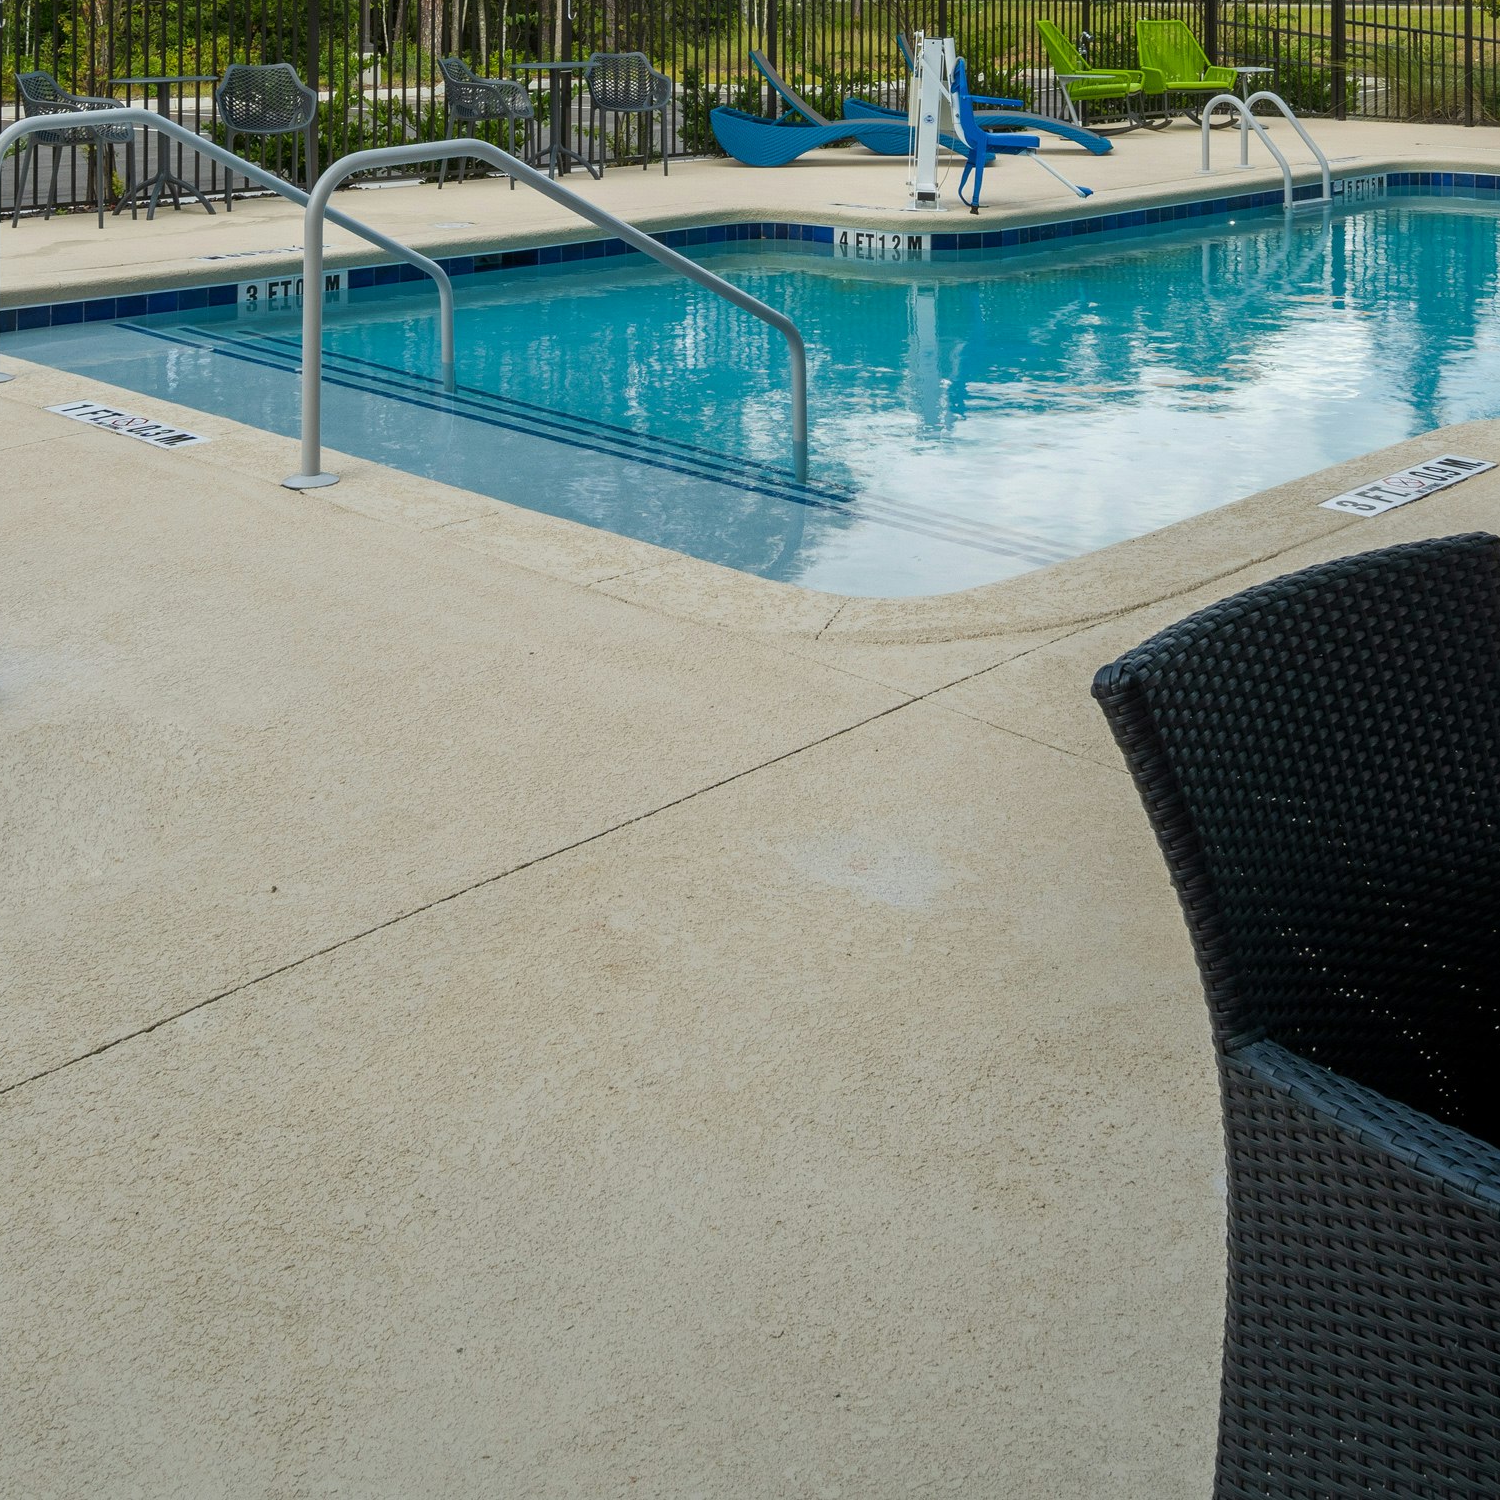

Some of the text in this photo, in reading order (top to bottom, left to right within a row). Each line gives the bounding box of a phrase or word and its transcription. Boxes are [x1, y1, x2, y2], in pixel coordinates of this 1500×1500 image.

[839, 231, 849, 245] 4
[246, 285, 257, 301] 3
[61, 404, 95, 412] 1
[76, 409, 125, 421] FT.
[127, 425, 176, 438] 0.3
[155, 434, 198, 446] M.
[1437, 458, 1486, 471] M.
[1409, 466, 1461, 482] 0.9
[1355, 486, 1411, 504] FT.
[1335, 500, 1377, 511] 3
